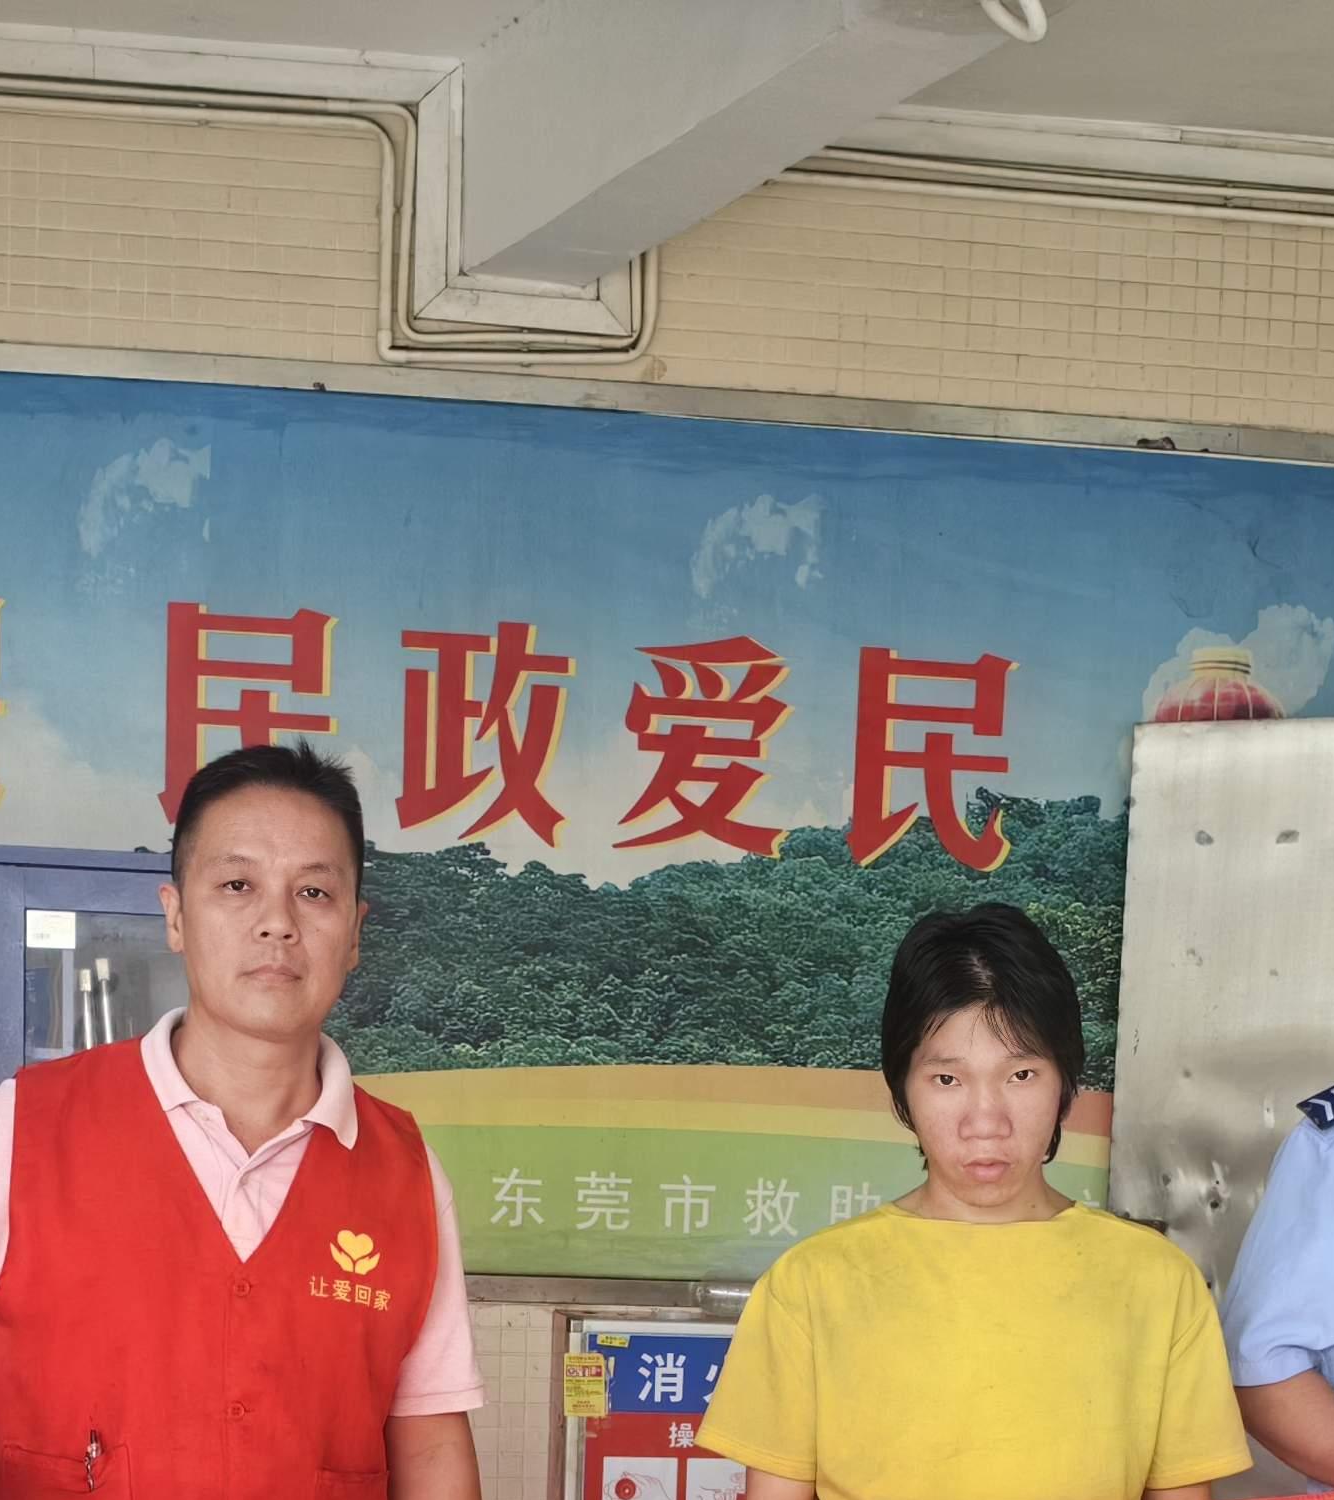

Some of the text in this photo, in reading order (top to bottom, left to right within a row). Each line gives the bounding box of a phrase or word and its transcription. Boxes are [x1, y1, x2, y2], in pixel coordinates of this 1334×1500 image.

[157, 601, 1020, 873] 民政爱民
[309, 1274, 392, 1313] 让爱回家
